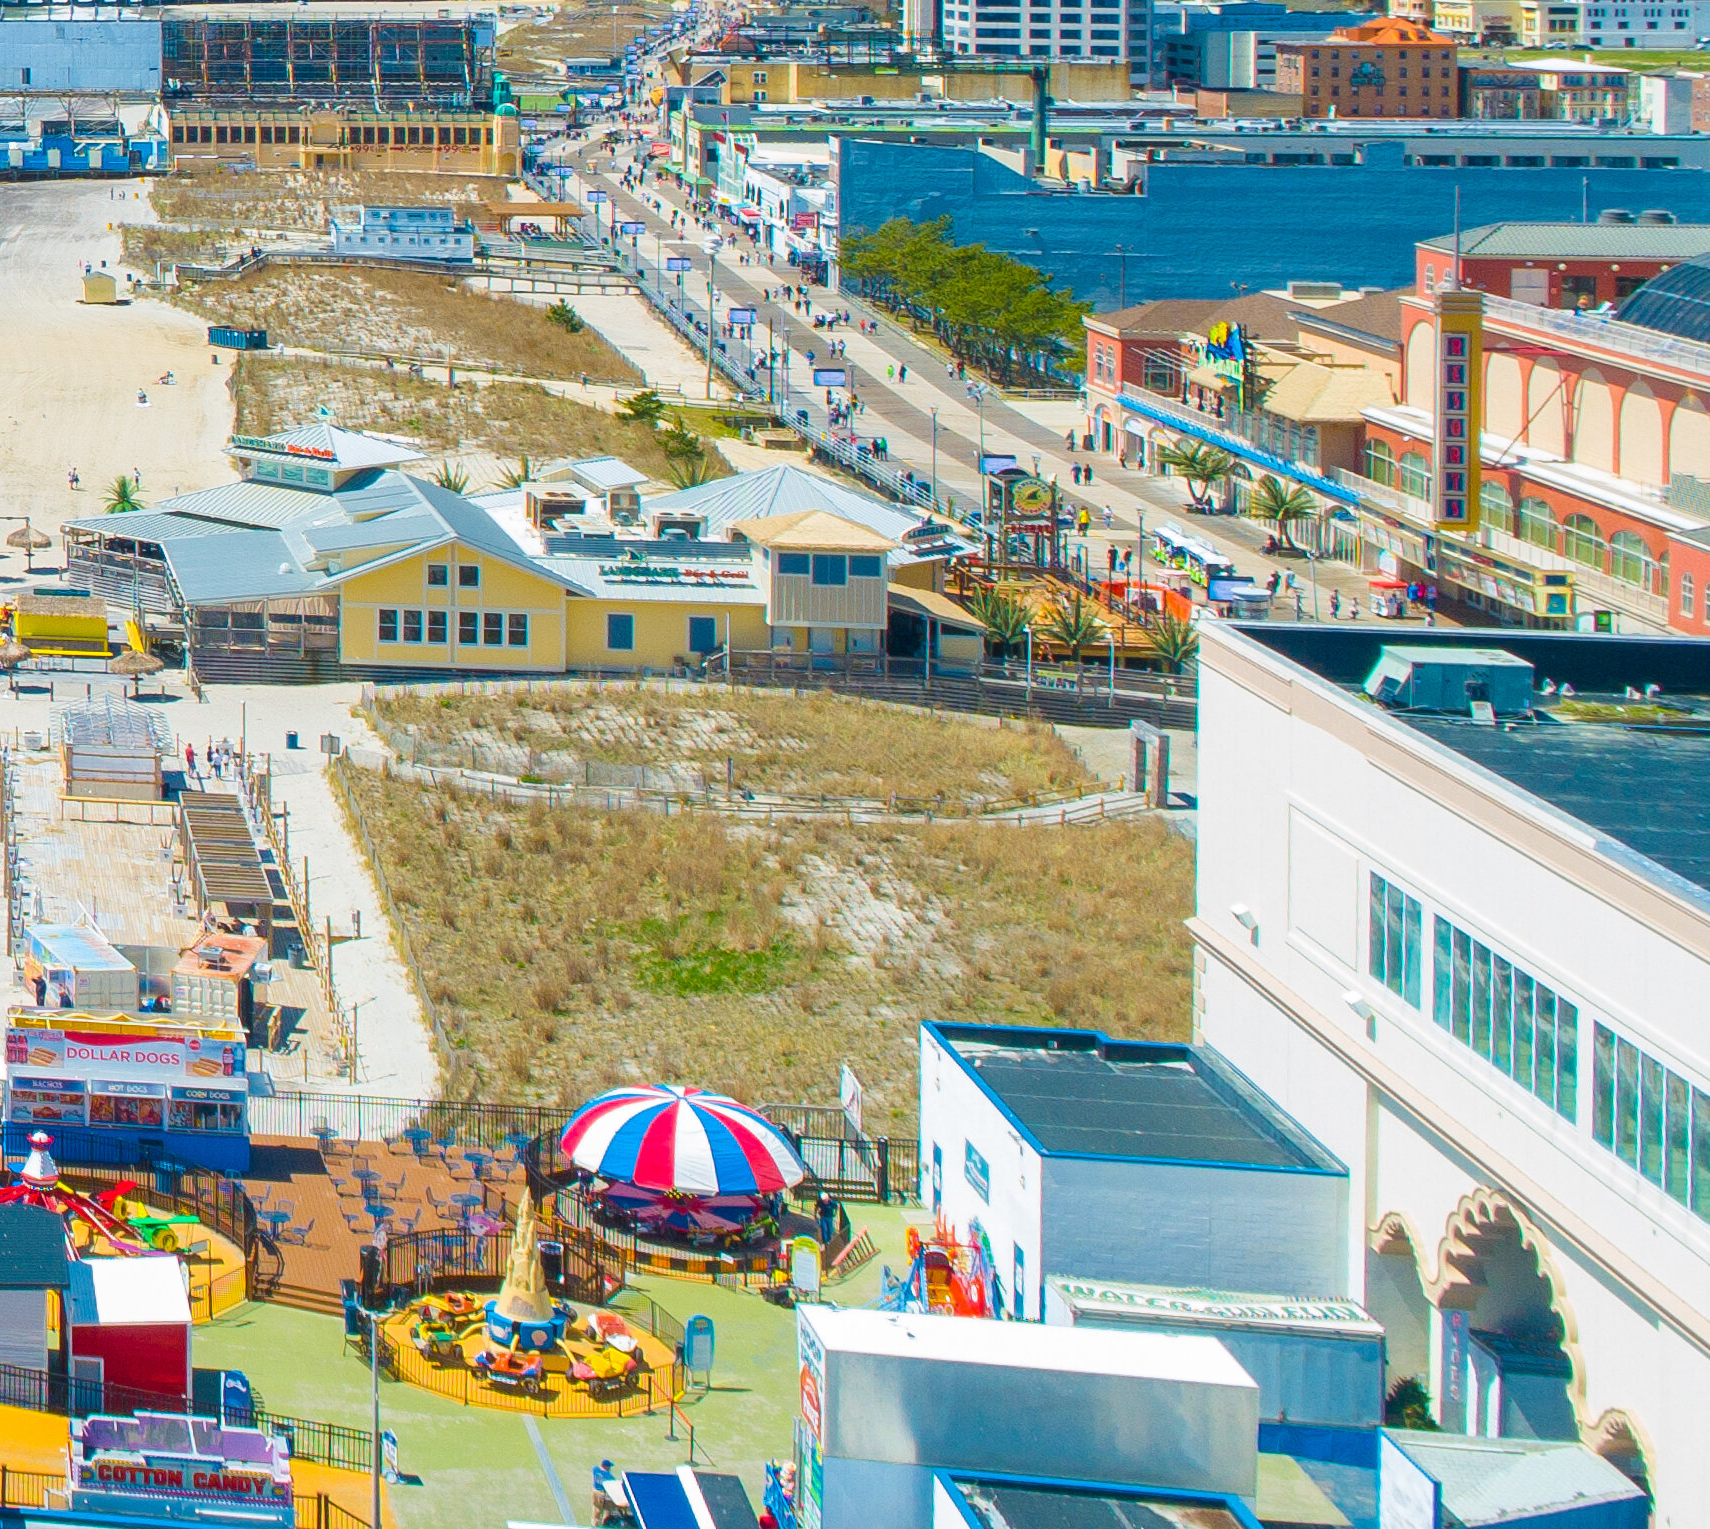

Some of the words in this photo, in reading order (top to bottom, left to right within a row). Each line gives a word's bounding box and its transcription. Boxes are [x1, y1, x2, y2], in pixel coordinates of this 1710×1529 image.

[1449, 335, 1464, 518] RESORTS
[66, 1046, 130, 1062] DOLLAR
[135, 1050, 180, 1065] DOGS
[32, 1080, 63, 1089] NACHOS
[108, 1084, 124, 1092] HOT
[126, 1084, 148, 1094] DOGS
[186, 1089, 207, 1099] CORN
[209, 1090, 231, 1100] DOGS
[1060, 1283, 1193, 1312] WATER
[97, 1464, 183, 1488] COTTON
[193, 1472, 267, 1495] CANDY
